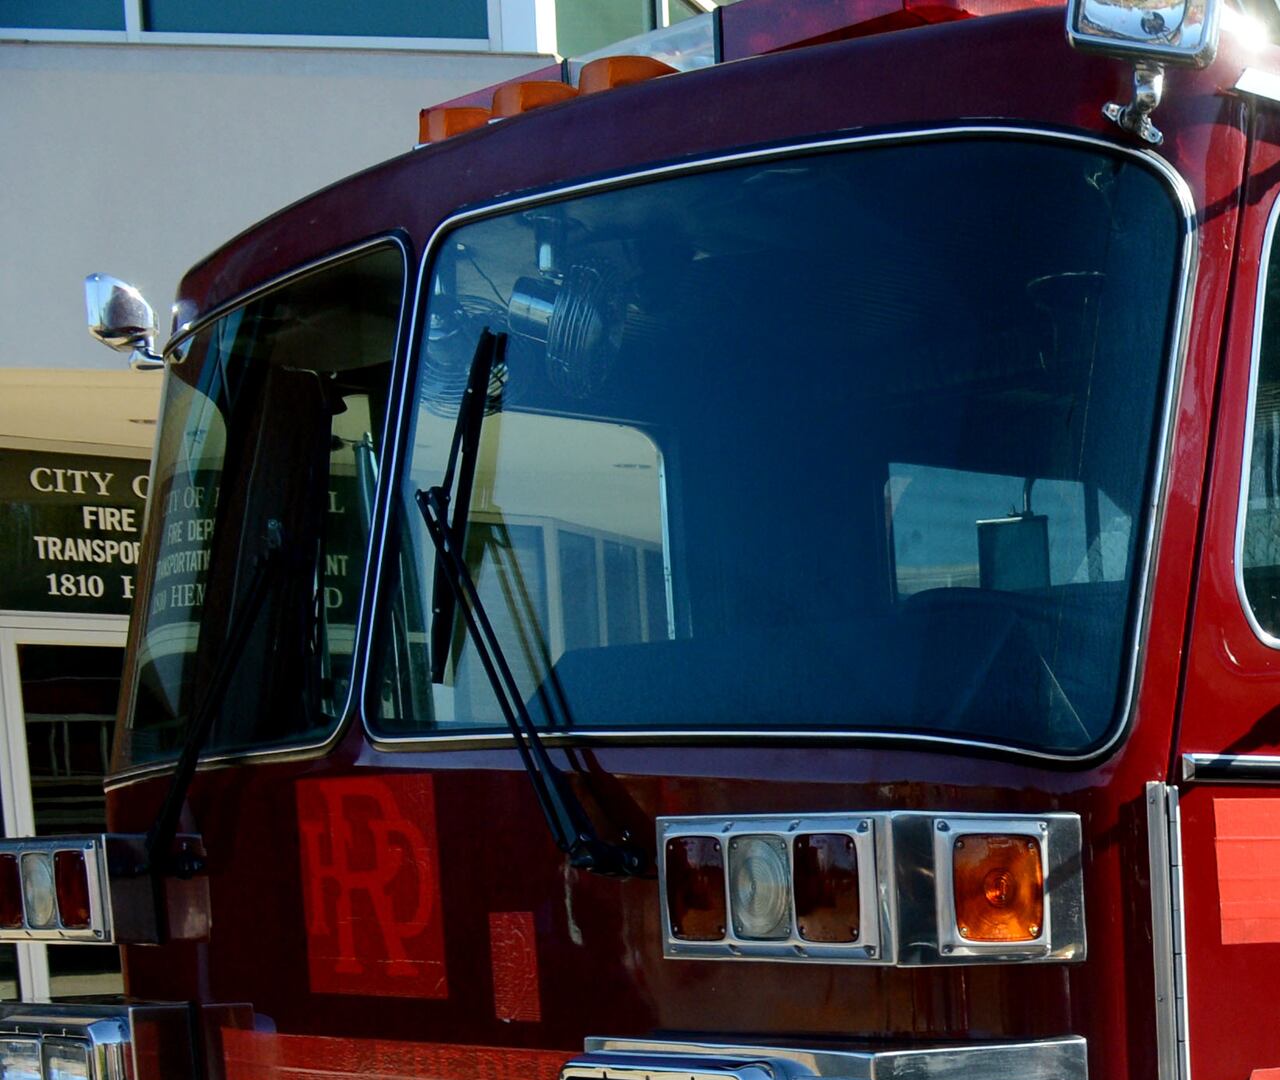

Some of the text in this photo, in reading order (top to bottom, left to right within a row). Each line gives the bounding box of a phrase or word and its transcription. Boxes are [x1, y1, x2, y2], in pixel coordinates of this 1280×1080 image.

[30, 467, 114, 496] CITY
[82, 505, 137, 532] FIRE
[46, 572, 104, 598] 1810
